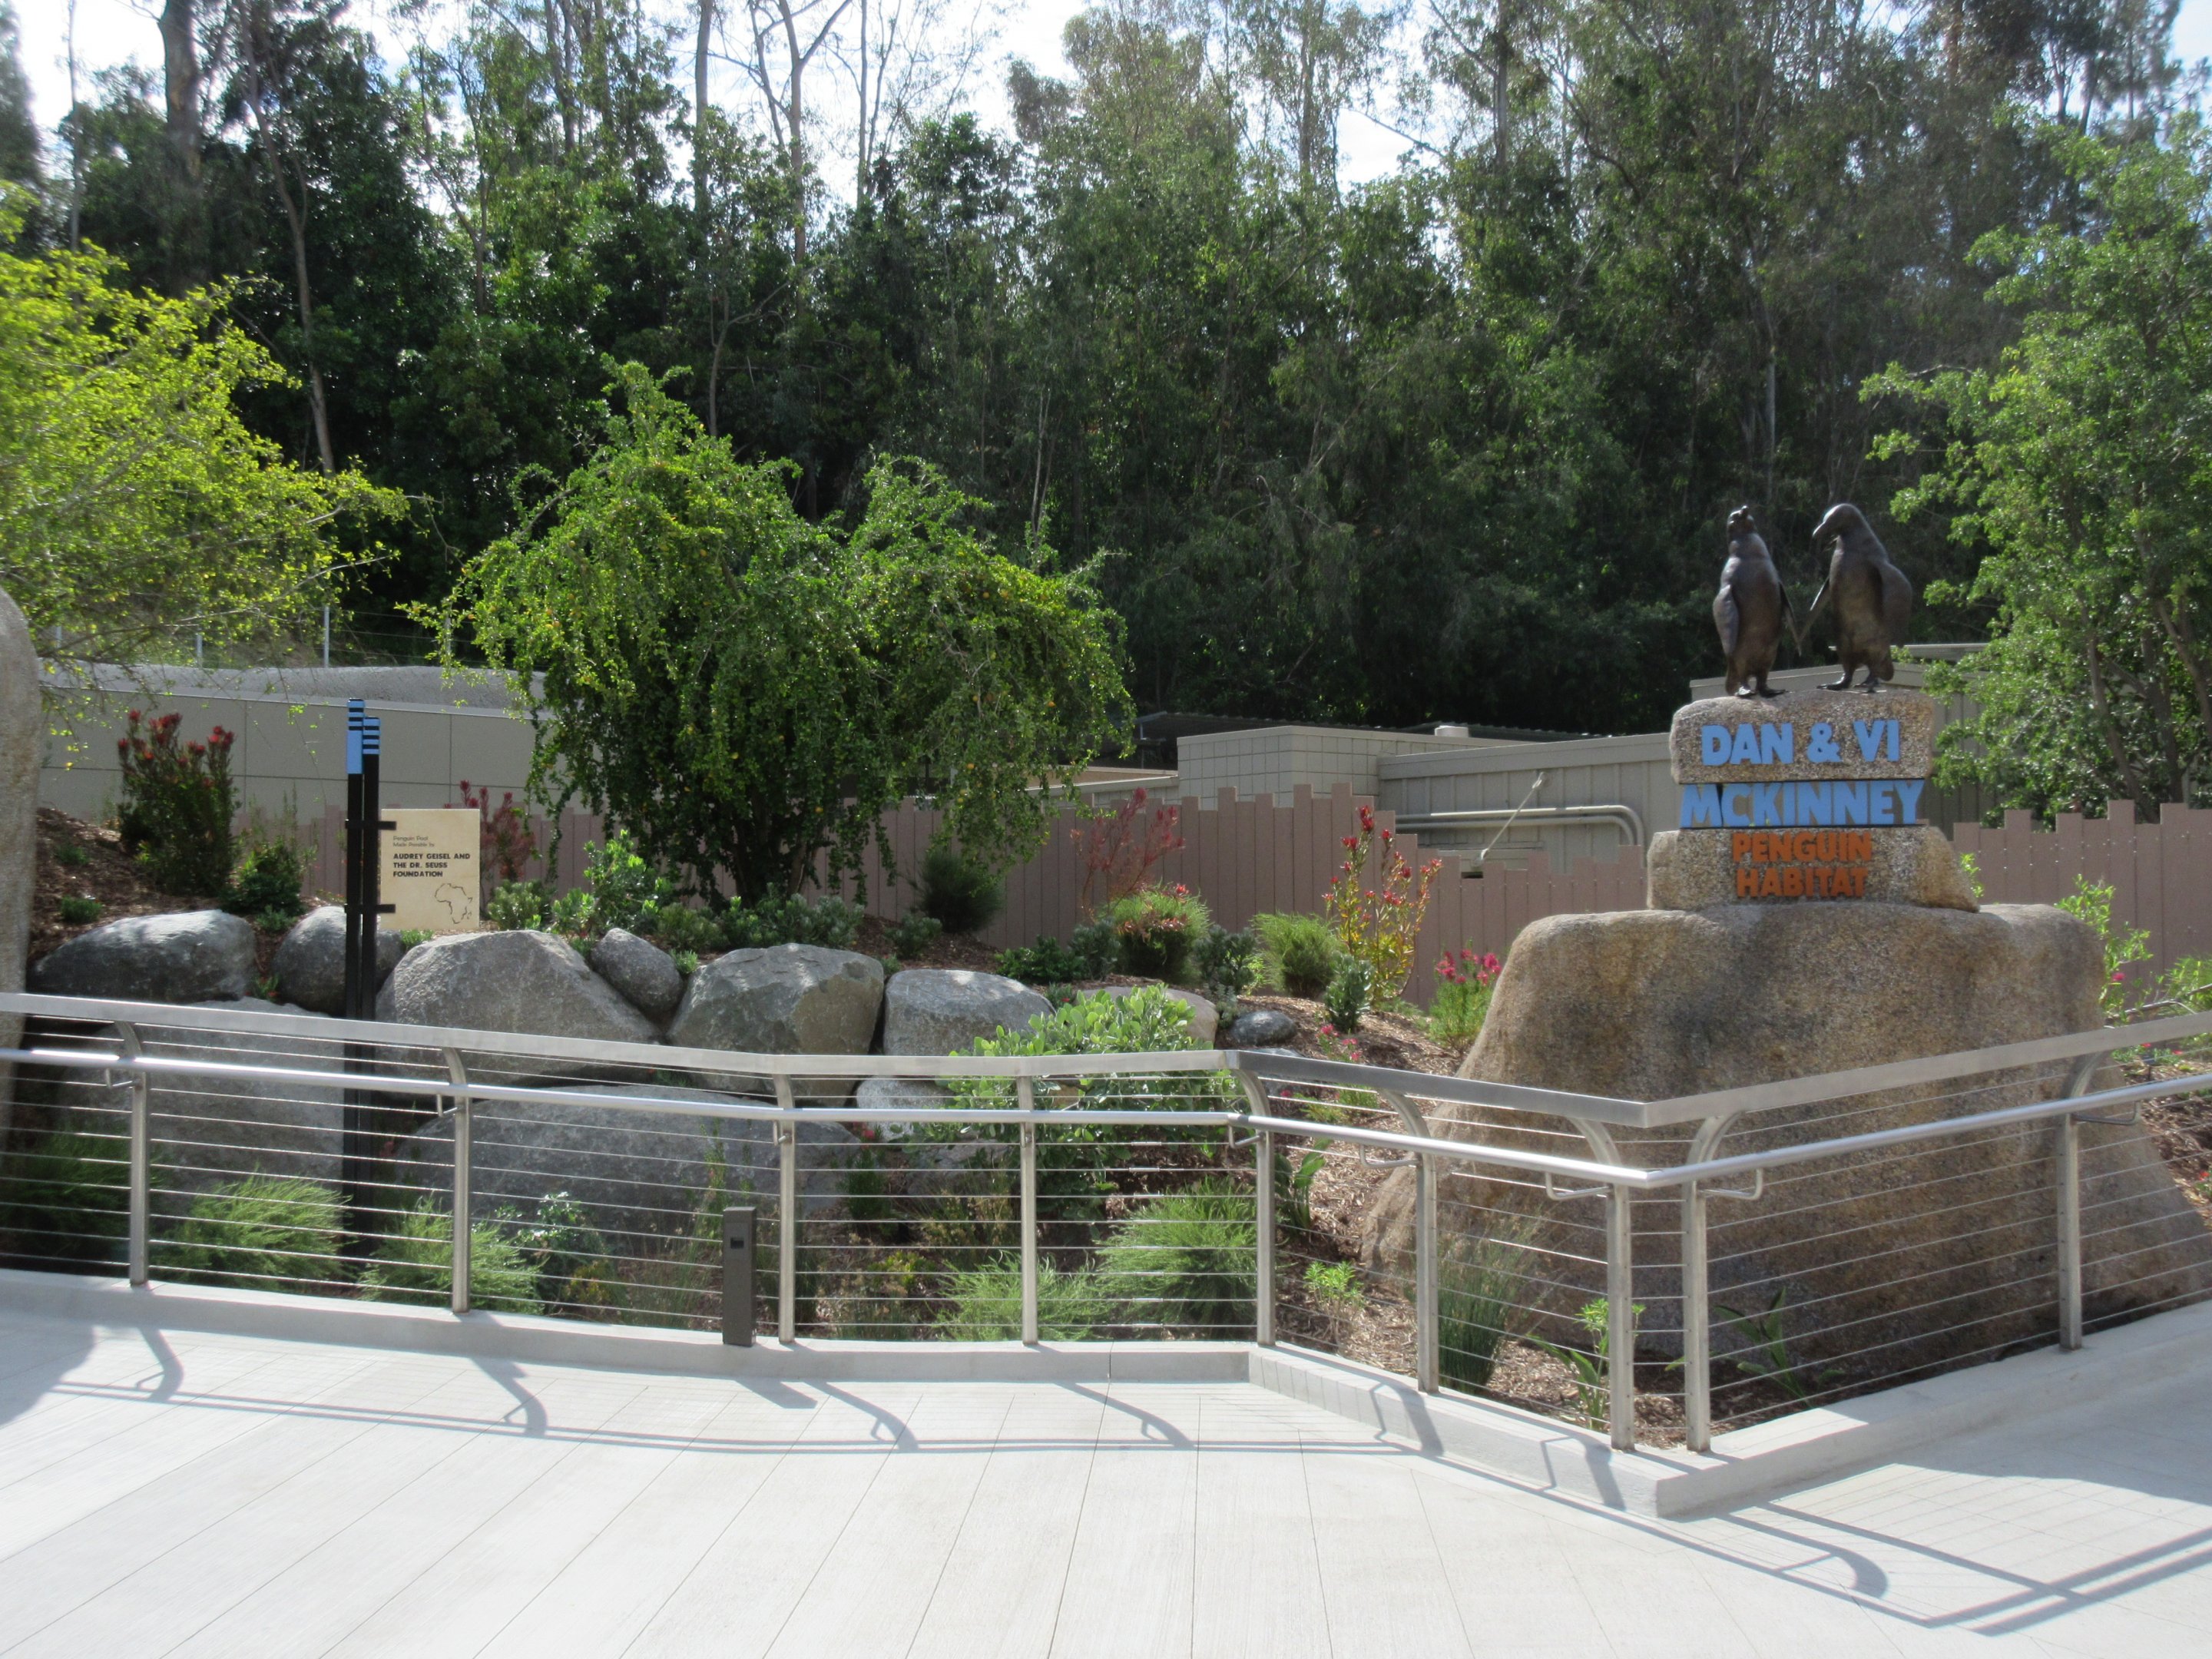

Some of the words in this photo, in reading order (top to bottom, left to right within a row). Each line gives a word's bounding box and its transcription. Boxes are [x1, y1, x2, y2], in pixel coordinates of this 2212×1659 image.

[1701, 722, 1794, 766] DAN
[1806, 722, 1843, 763] &
[1853, 719, 1900, 762] VI
[1680, 779, 1925, 829] MCKINNEY
[1732, 831, 1873, 863] PENGUIN
[1737, 867, 1869, 898] HABITAT
